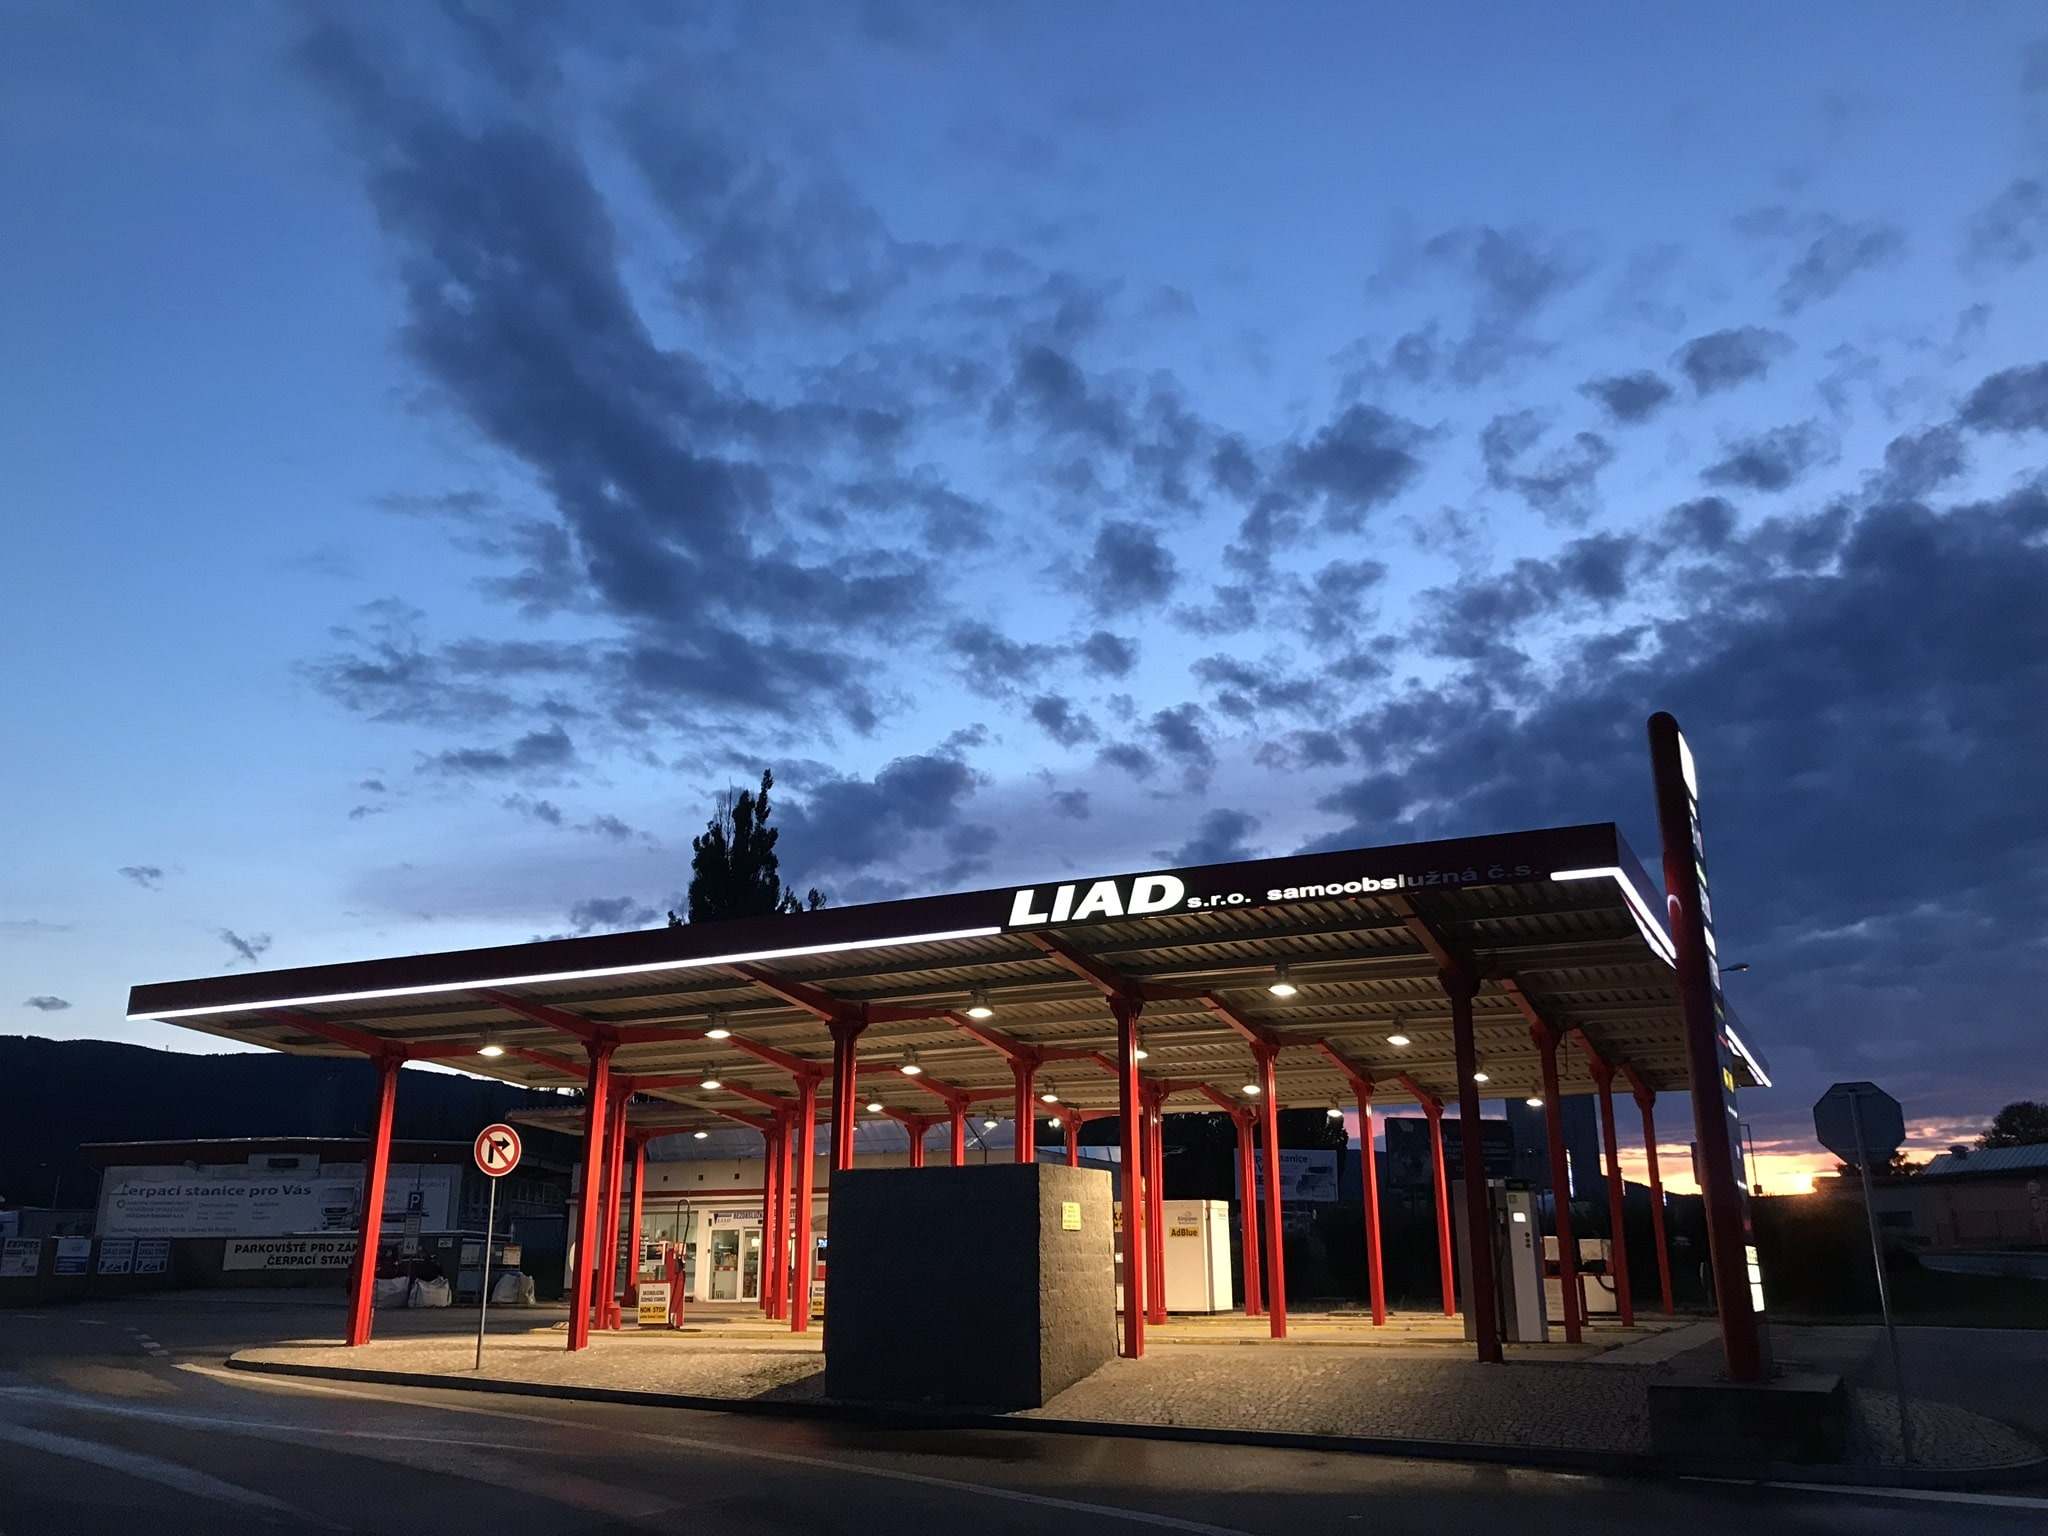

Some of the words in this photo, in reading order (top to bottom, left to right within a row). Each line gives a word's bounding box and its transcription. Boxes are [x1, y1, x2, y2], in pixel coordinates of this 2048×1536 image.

[1008, 874, 1185, 926] LIAD
[1187, 892, 1252, 909] s.r.o.
[1266, 867, 1479, 901] samoobslužná
[185, 1185, 246, 1197] stanice
[249, 1187, 279, 1198] pro
[282, 1184, 313, 1196] Vás
[1170, 1227, 1199, 1237] AdBlue
[310, 1243, 334, 1252] PRO
[267, 1253, 316, 1265] ČERPACÍ
